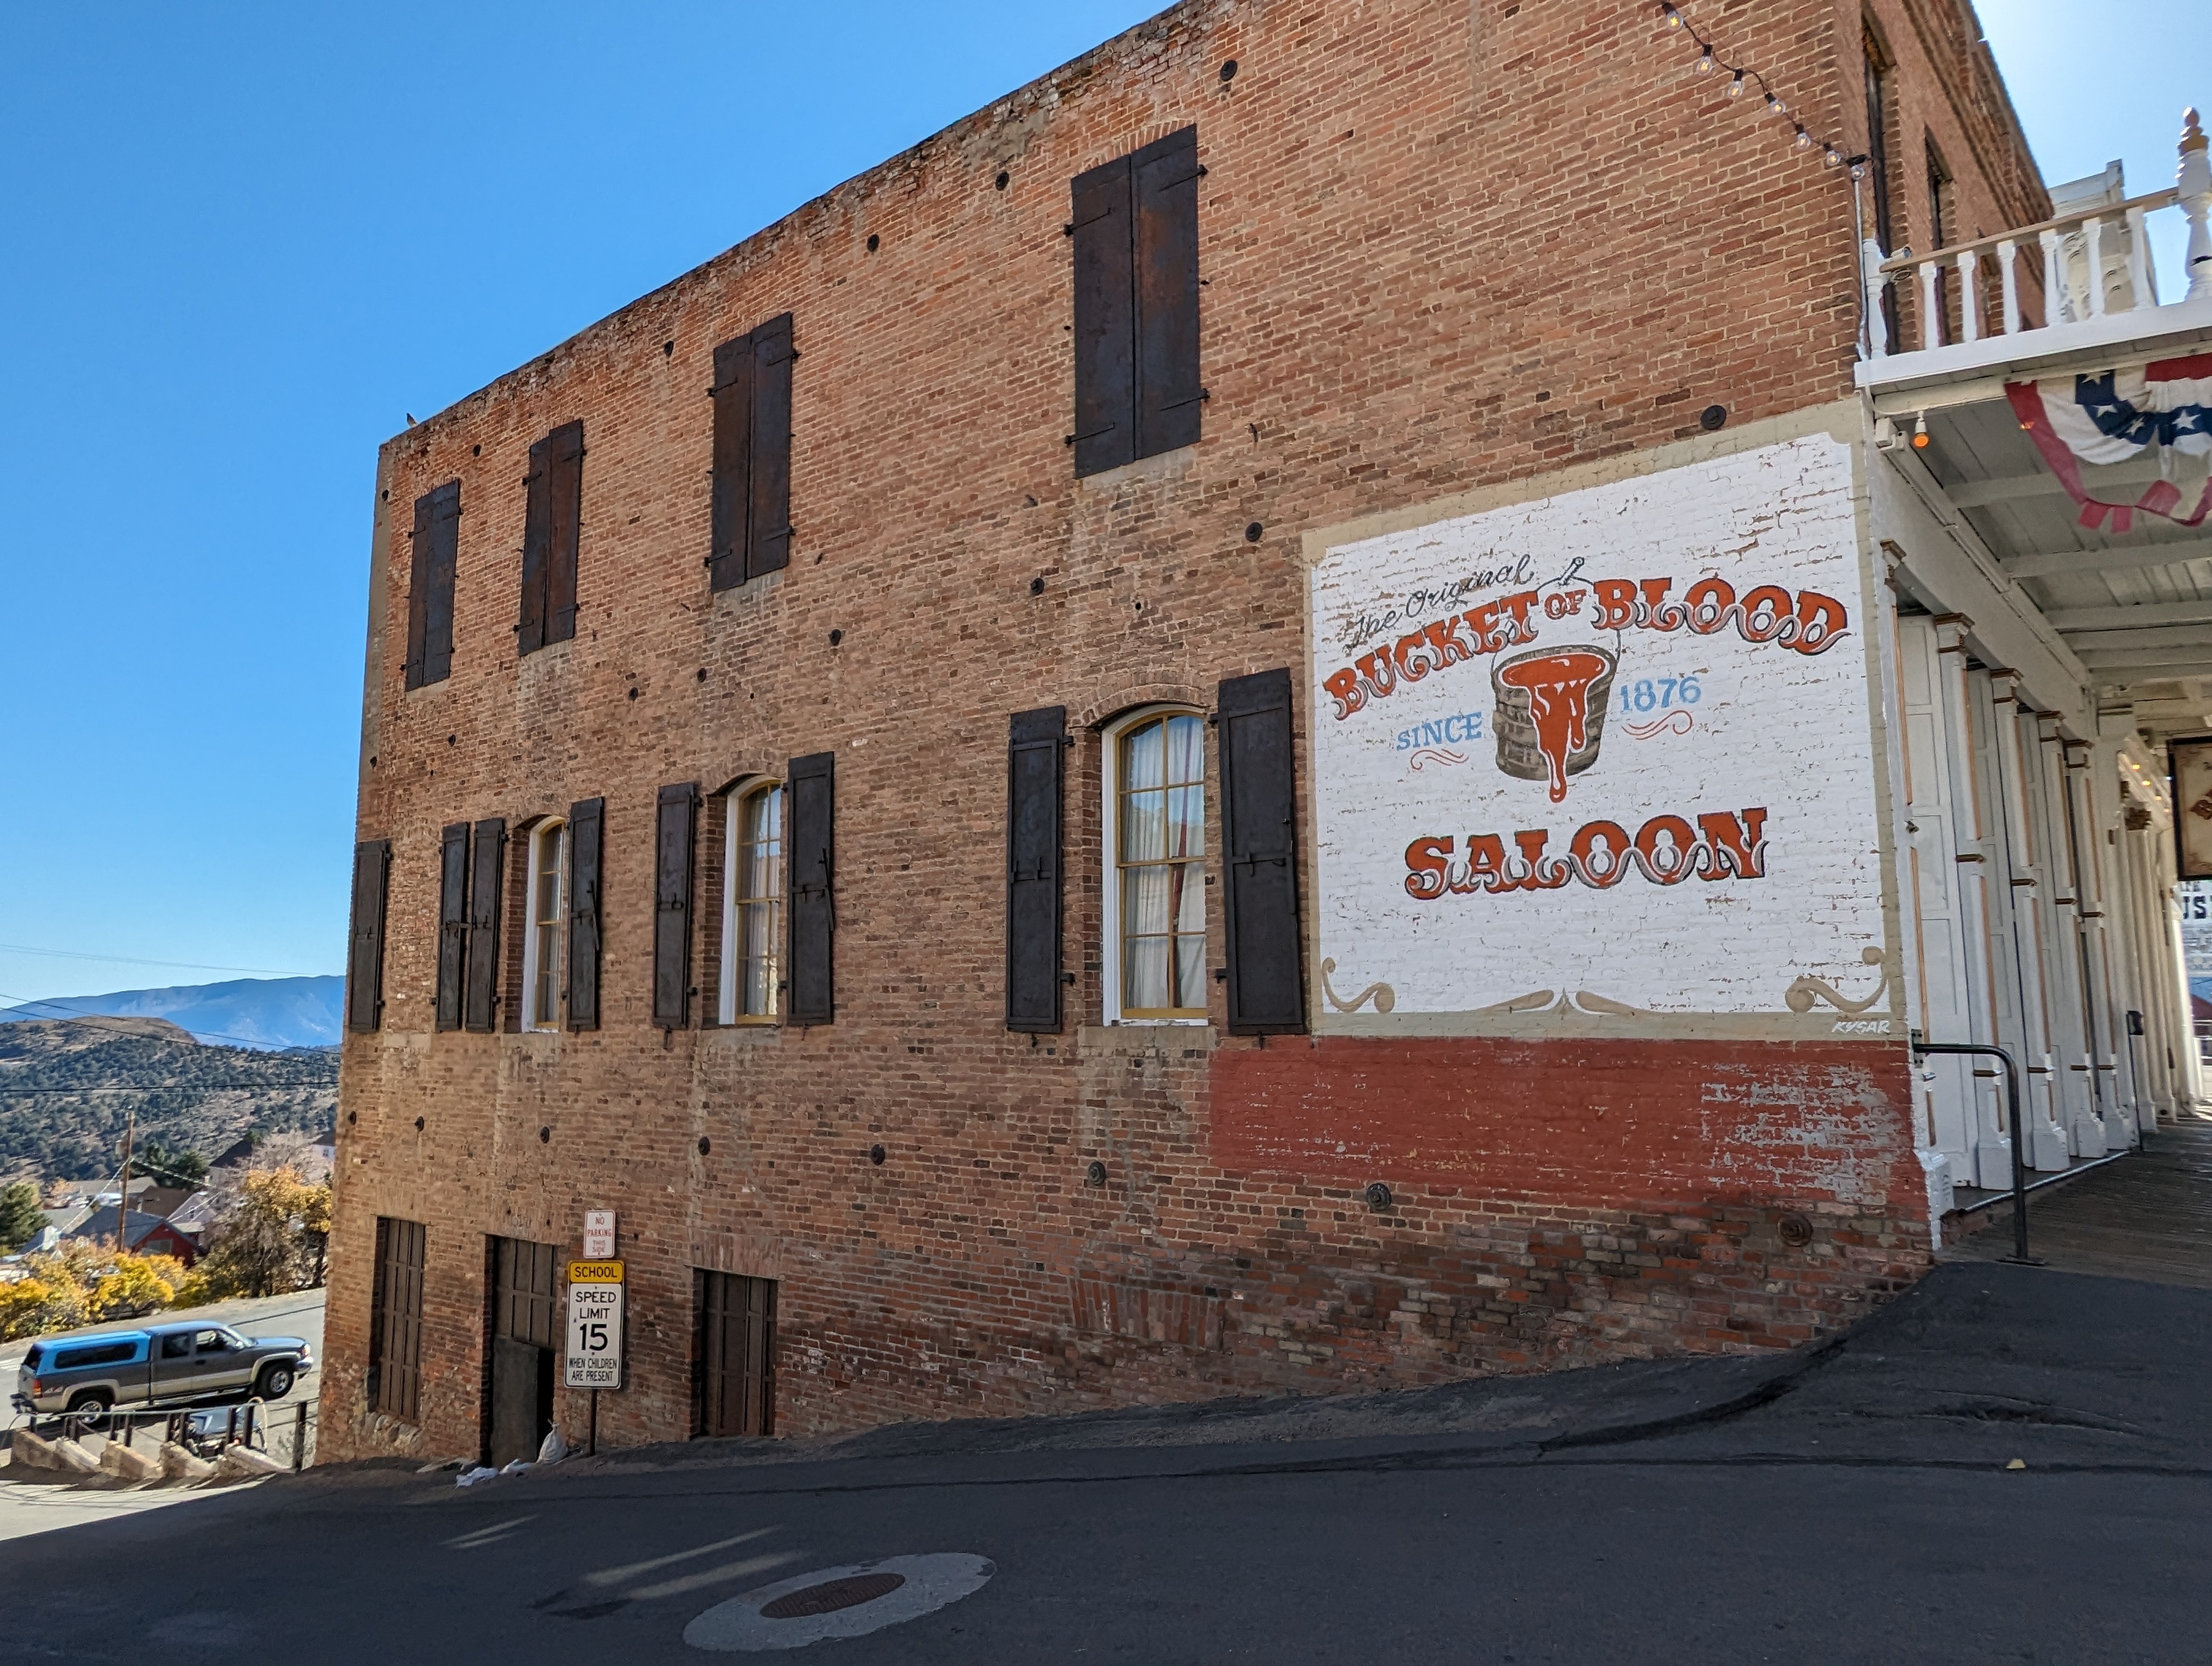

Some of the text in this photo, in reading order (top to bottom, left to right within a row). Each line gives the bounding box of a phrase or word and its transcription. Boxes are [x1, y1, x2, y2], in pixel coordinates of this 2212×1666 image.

[1343, 554, 1535, 657] The Original
[1322, 576, 1852, 721] BUCKET OF BLOOD
[1396, 676, 1702, 751] SINCE 1876
[1404, 806, 1770, 900] SALOON
[595, 1216, 605, 1225] NO
[587, 1229, 612, 1237] PARKING
[575, 1266, 617, 1278] SCHOOL
[575, 1291, 616, 1303] SPEED
[580, 1308, 610, 1319] LIMIT
[580, 1323, 608, 1351] 15
[569, 1357, 617, 1369] WHEN CHILDREN
[571, 1370, 613, 1382] ARE PRESENT
